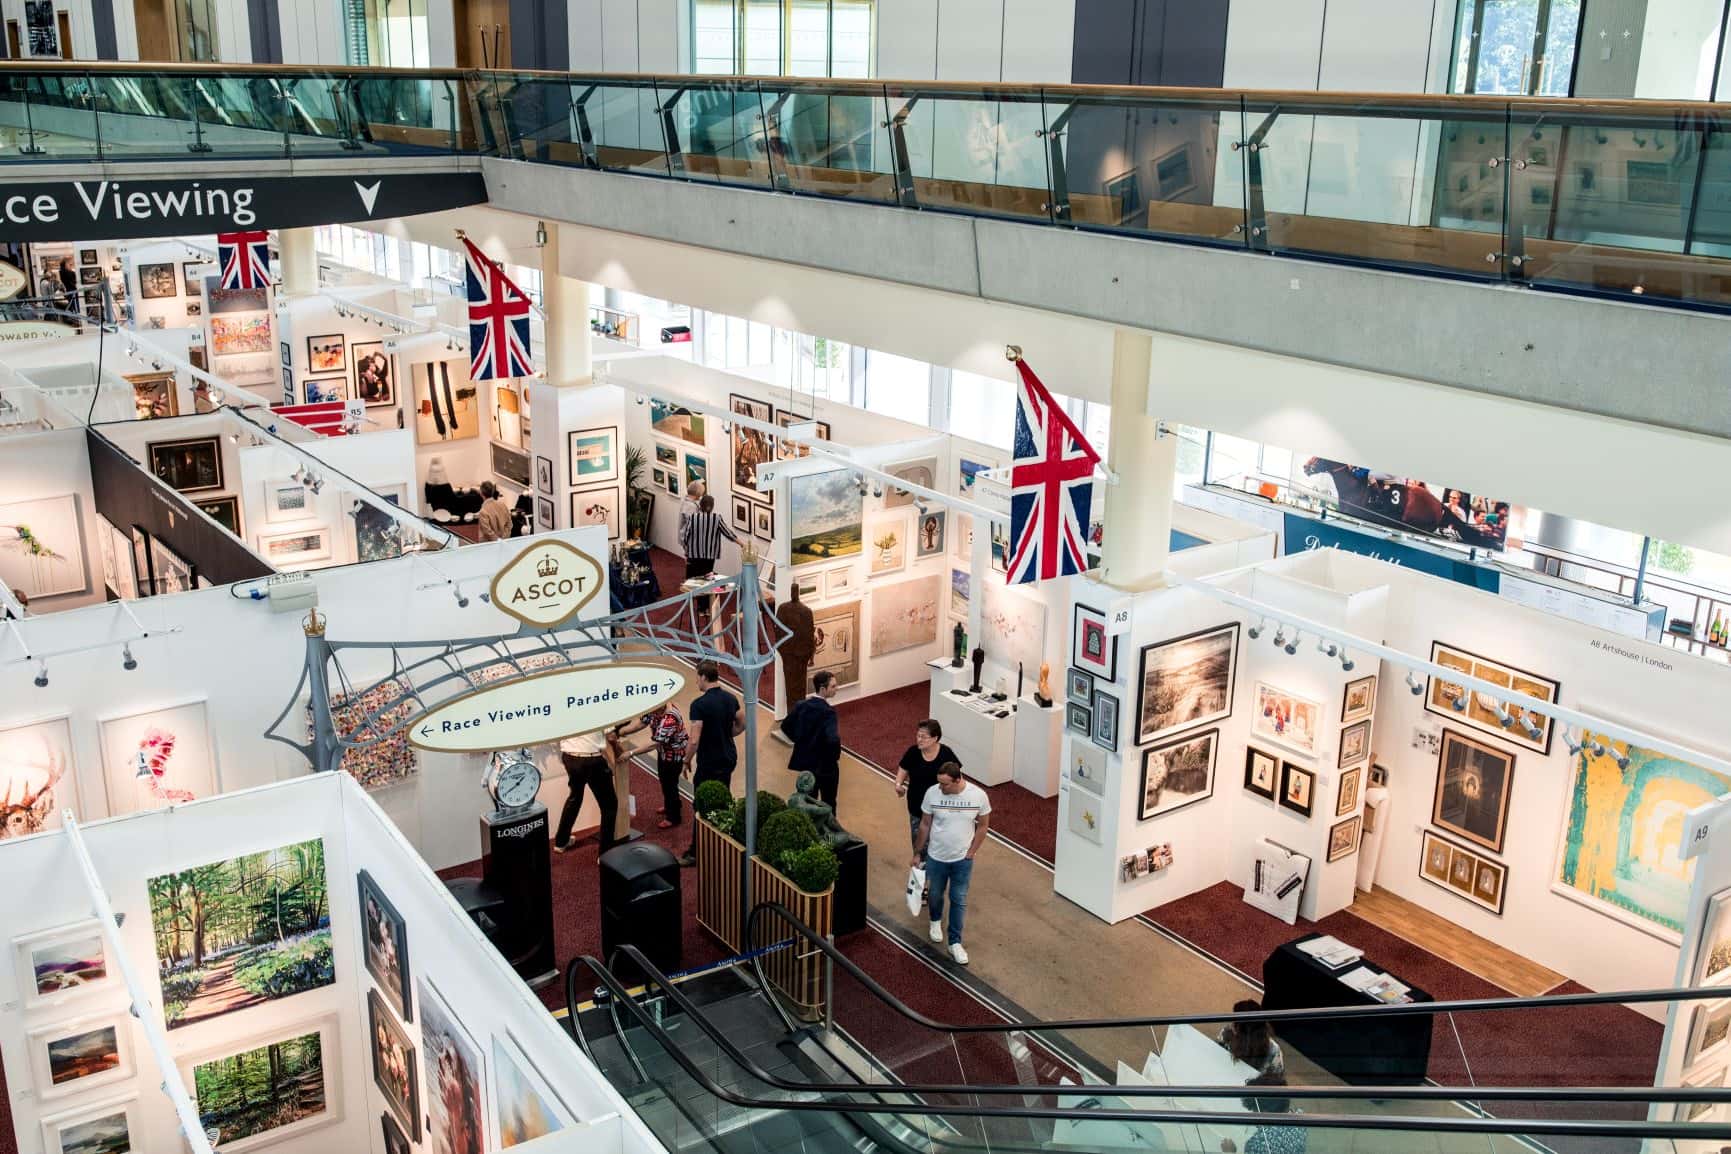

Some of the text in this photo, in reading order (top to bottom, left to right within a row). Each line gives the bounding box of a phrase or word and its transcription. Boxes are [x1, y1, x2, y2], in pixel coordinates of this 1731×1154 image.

[0, 181, 256, 226] ce Viewing
[763, 472, 775, 482] A7
[1391, 489, 1400, 505] 3
[511, 576, 586, 603] ASCOT
[1115, 611, 1128, 623] A8
[1602, 643, 1640, 661] Artshouse
[1645, 656, 1673, 671] London
[567, 682, 659, 708] Parade Ring
[442, 704, 551, 733] Race Viewing
[497, 818, 544, 838] LONGINES
[1694, 825, 1709, 842] A9
